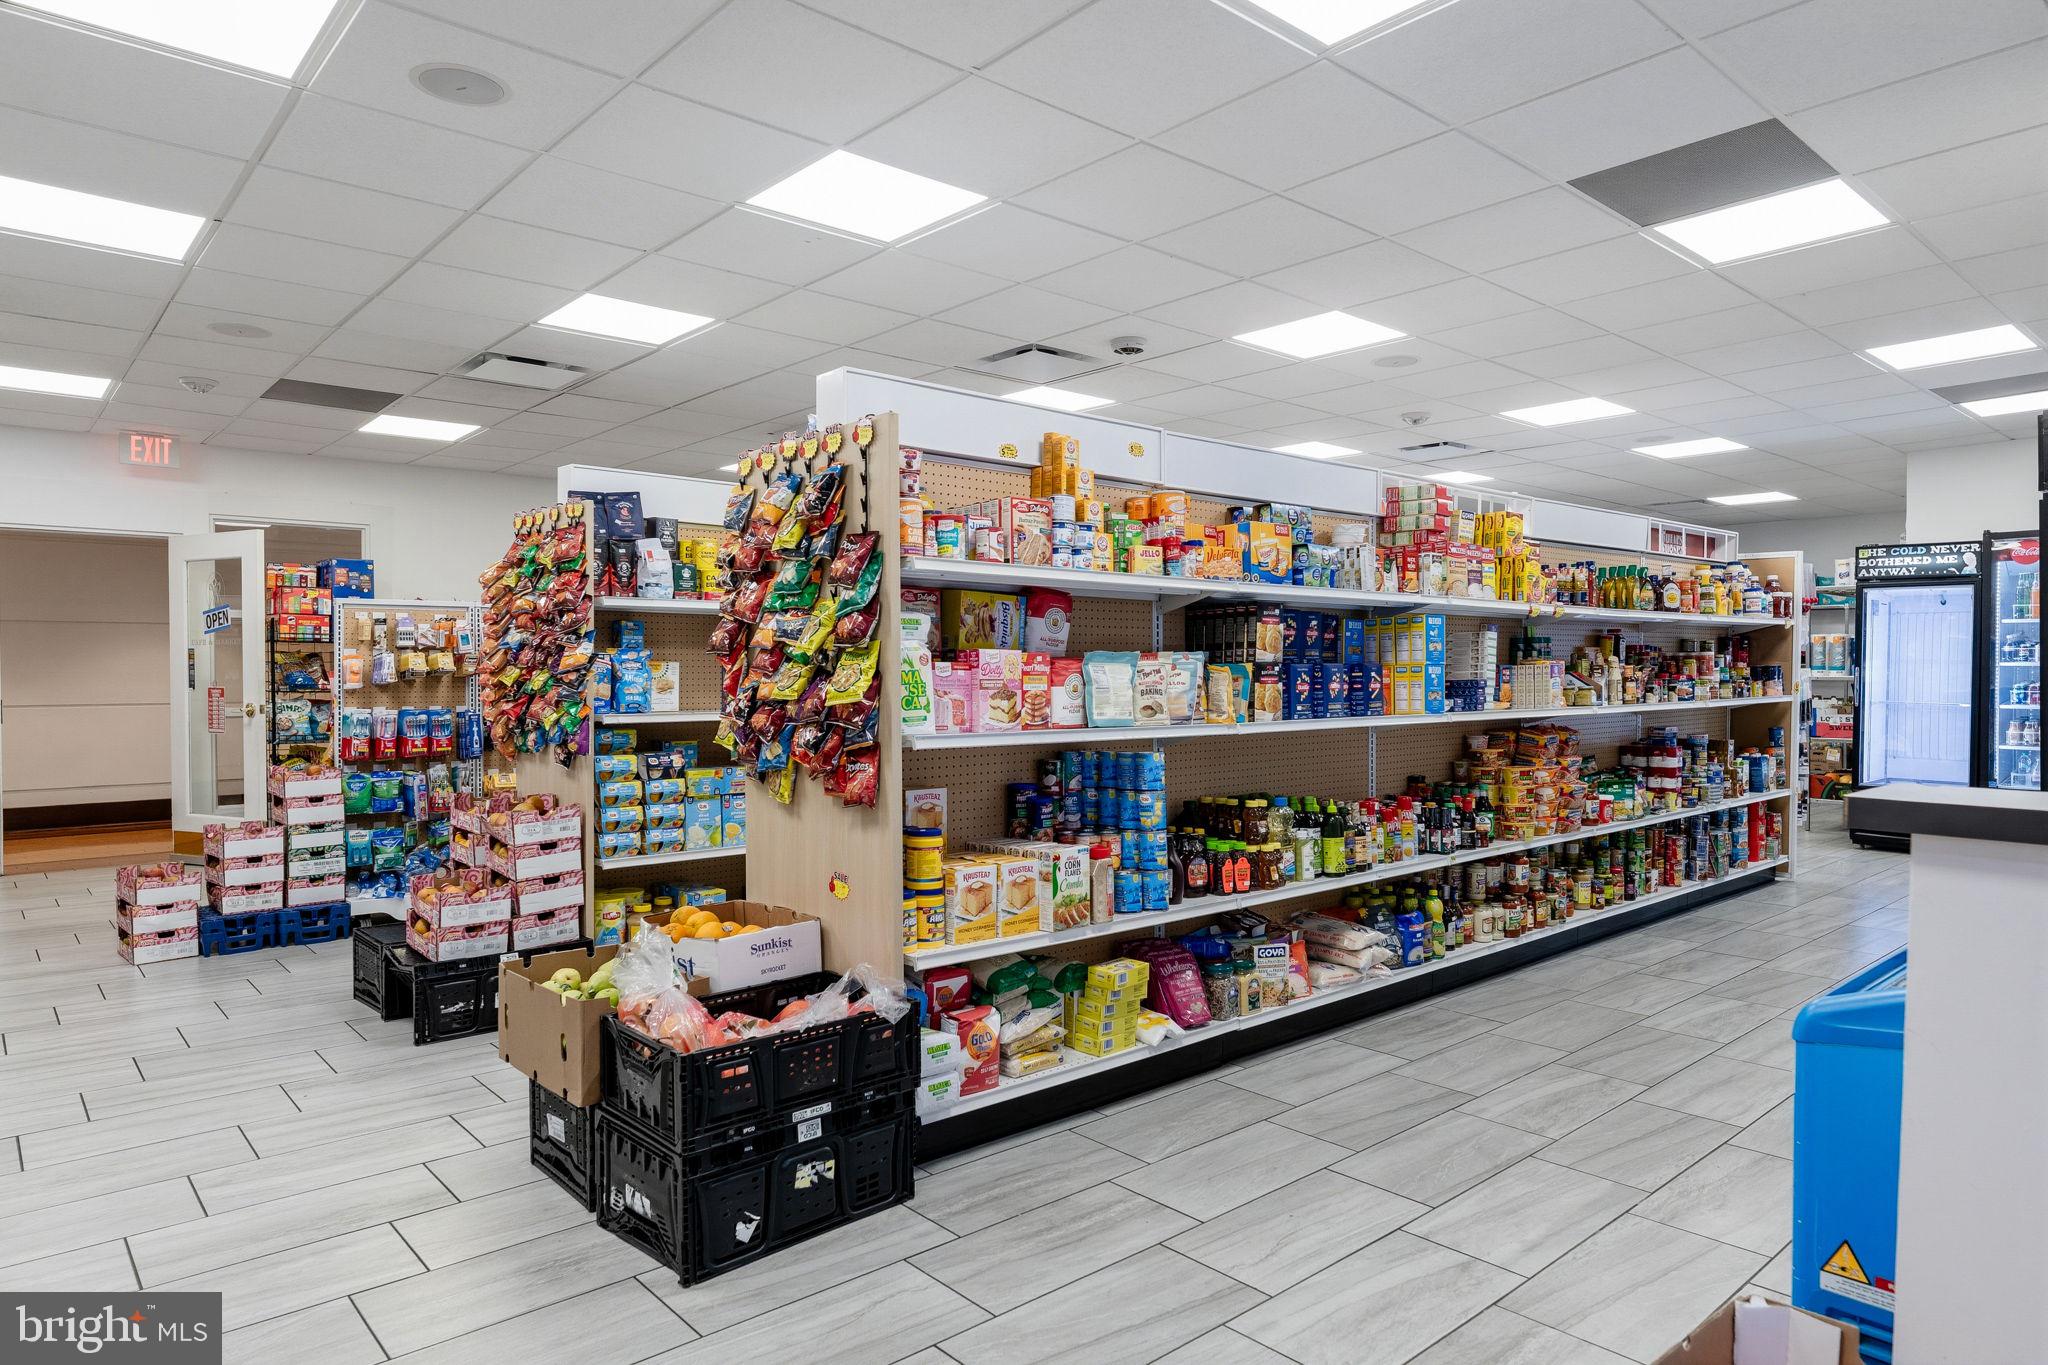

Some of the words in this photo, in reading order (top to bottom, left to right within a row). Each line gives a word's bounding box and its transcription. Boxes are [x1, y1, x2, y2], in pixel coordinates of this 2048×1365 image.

[130, 435, 171, 464] EXIT
[1859, 548, 1886, 557] HE
[1891, 546, 1926, 555] COLD
[1930, 543, 1981, 553] NEVER
[1859, 555, 1931, 567] BOTHERED
[1935, 554, 1957, 564] ME
[1858, 566, 1917, 577] ANYWAY
[205, 609, 229, 630] OPEN
[1000, 601, 1011, 648] Bisquick
[913, 793, 941, 802] KRUSTEAZ
[1064, 860, 1081, 869] CORN
[963, 871, 991, 881] KRUSTEAZ
[1008, 866, 1034, 876] KRUSTEAZ
[1064, 868, 1082, 877] FLAKES
[750, 937, 793, 956] Sunkist
[1259, 946, 1285, 957] GOYA
[971, 1031, 993, 1046] GOLD
